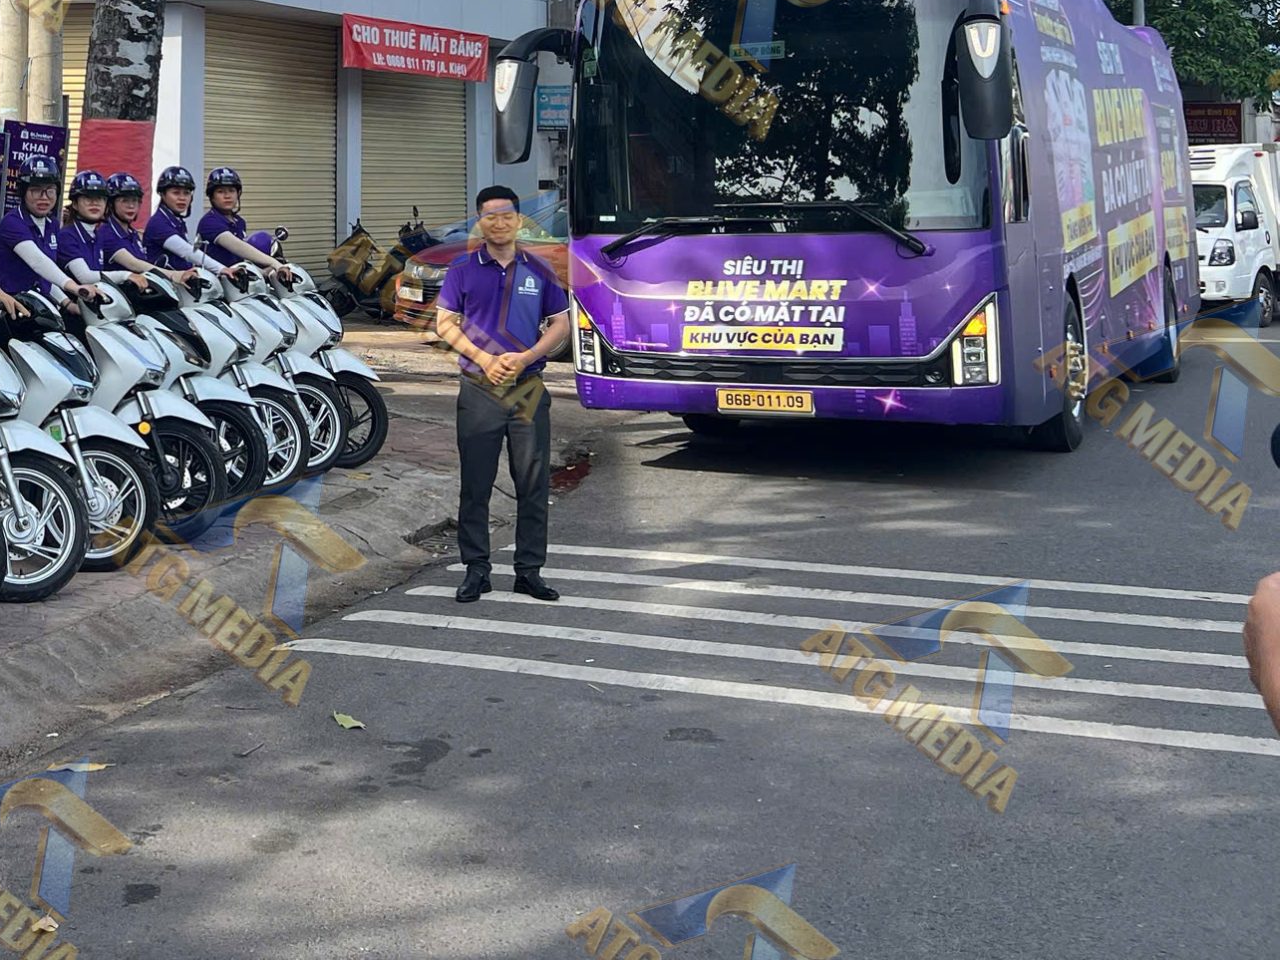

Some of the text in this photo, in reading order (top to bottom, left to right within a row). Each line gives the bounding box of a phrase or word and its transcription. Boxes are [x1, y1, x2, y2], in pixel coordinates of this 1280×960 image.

[352, 24, 380, 45] CHO
[383, 29, 417, 50] THUÊ
[22, 141, 48, 154] KHAI
[723, 255, 804, 279] SIÊU THỊ
[687, 280, 848, 300] BLIVE MART
[684, 300, 846, 327] ĐÃ CÓ MẶT TẠI
[689, 328, 835, 348] KHU VỰC CỦA BẠN
[726, 392, 805, 409] 86B-011.09
